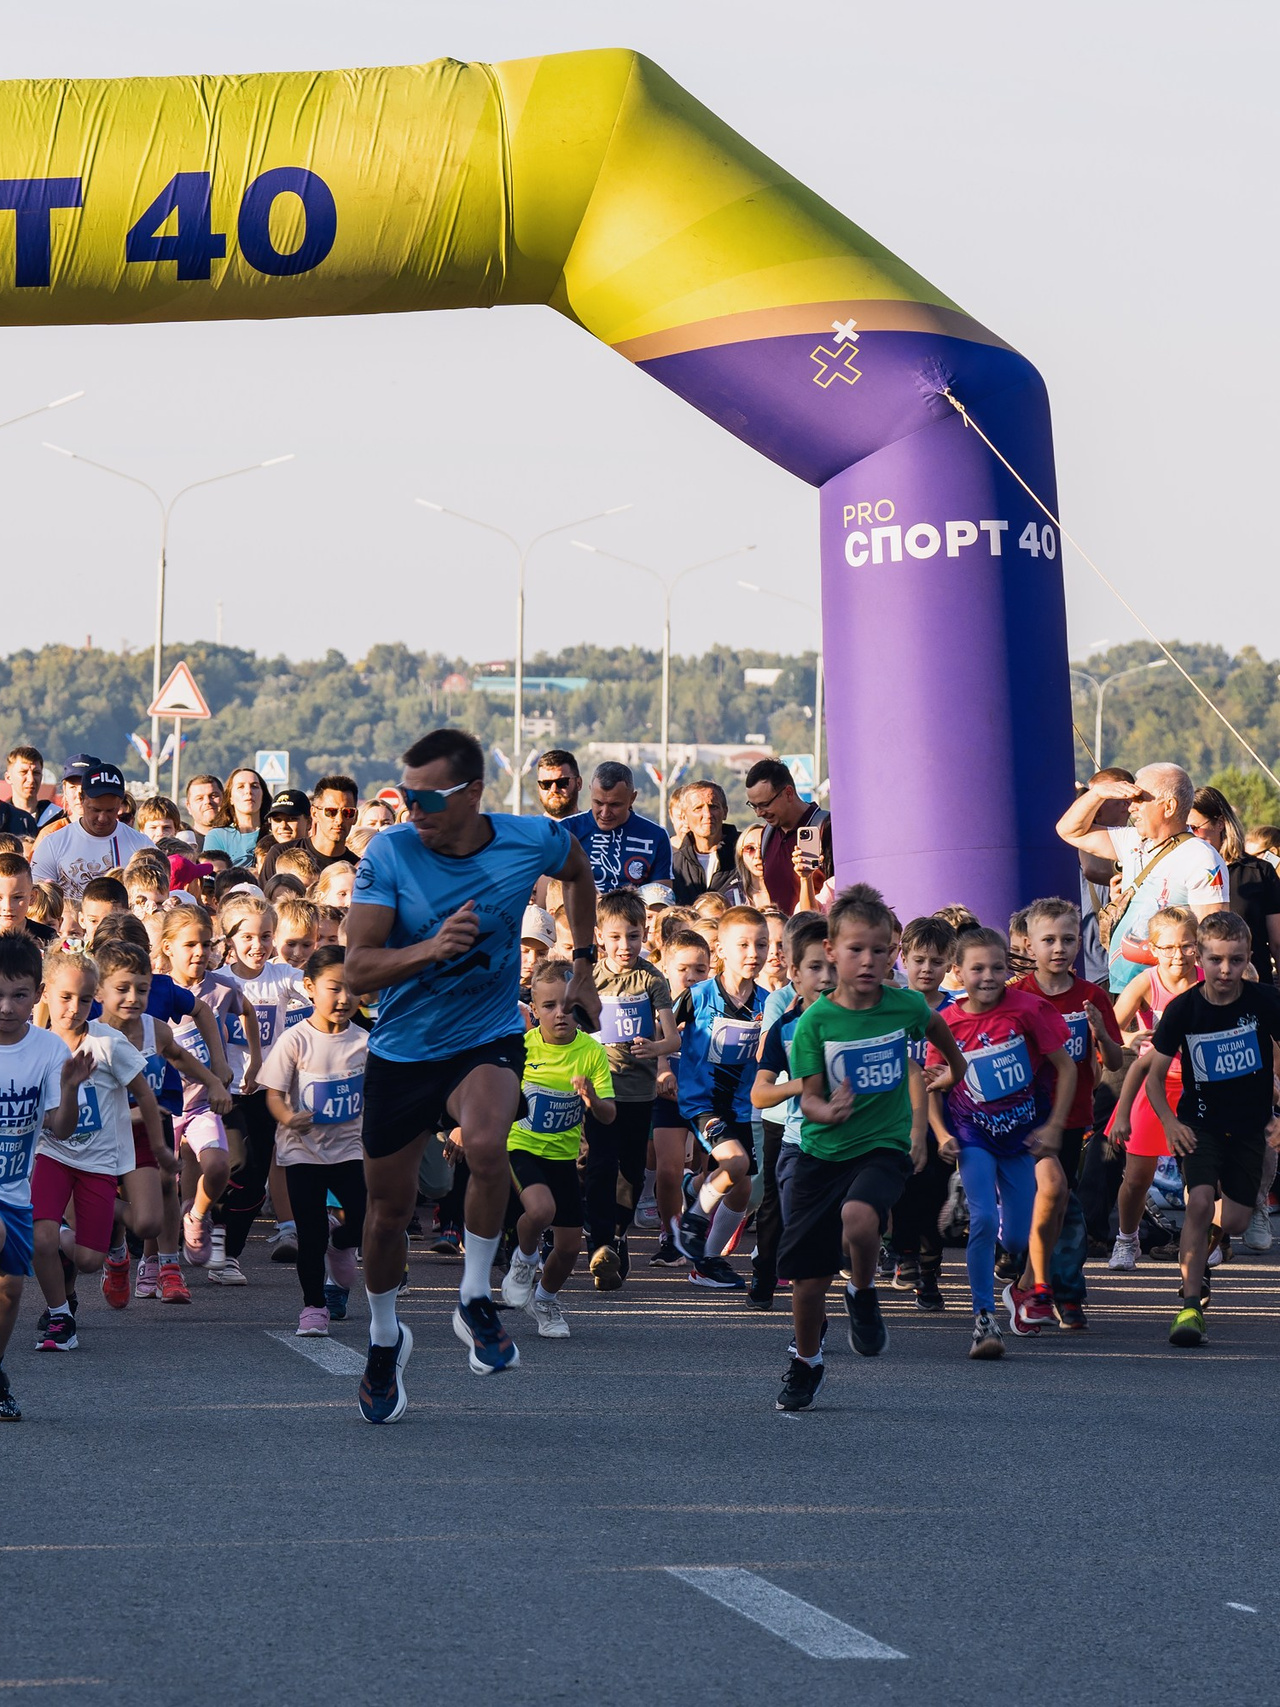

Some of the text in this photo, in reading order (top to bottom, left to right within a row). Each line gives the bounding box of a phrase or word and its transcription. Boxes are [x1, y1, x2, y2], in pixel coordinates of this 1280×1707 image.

[125, 166, 337, 281] 40
[843, 499, 895, 528] PRO
[845, 520, 1056, 567] СПОРТ 40
[91, 772, 121, 784] FILA
[616, 1008, 638, 1017] АРТЕМ
[615, 1017, 642, 1037] 197
[1217, 1040, 1245, 1053] БОГДАН
[856, 1058, 902, 1088] 3594
[992, 1053, 1018, 1069] АЛИСА
[1215, 1047, 1256, 1074] 4920
[994, 1062, 1025, 1090] 170
[336, 1084, 350, 1095] ЕВА
[322, 1093, 360, 1118] 4712
